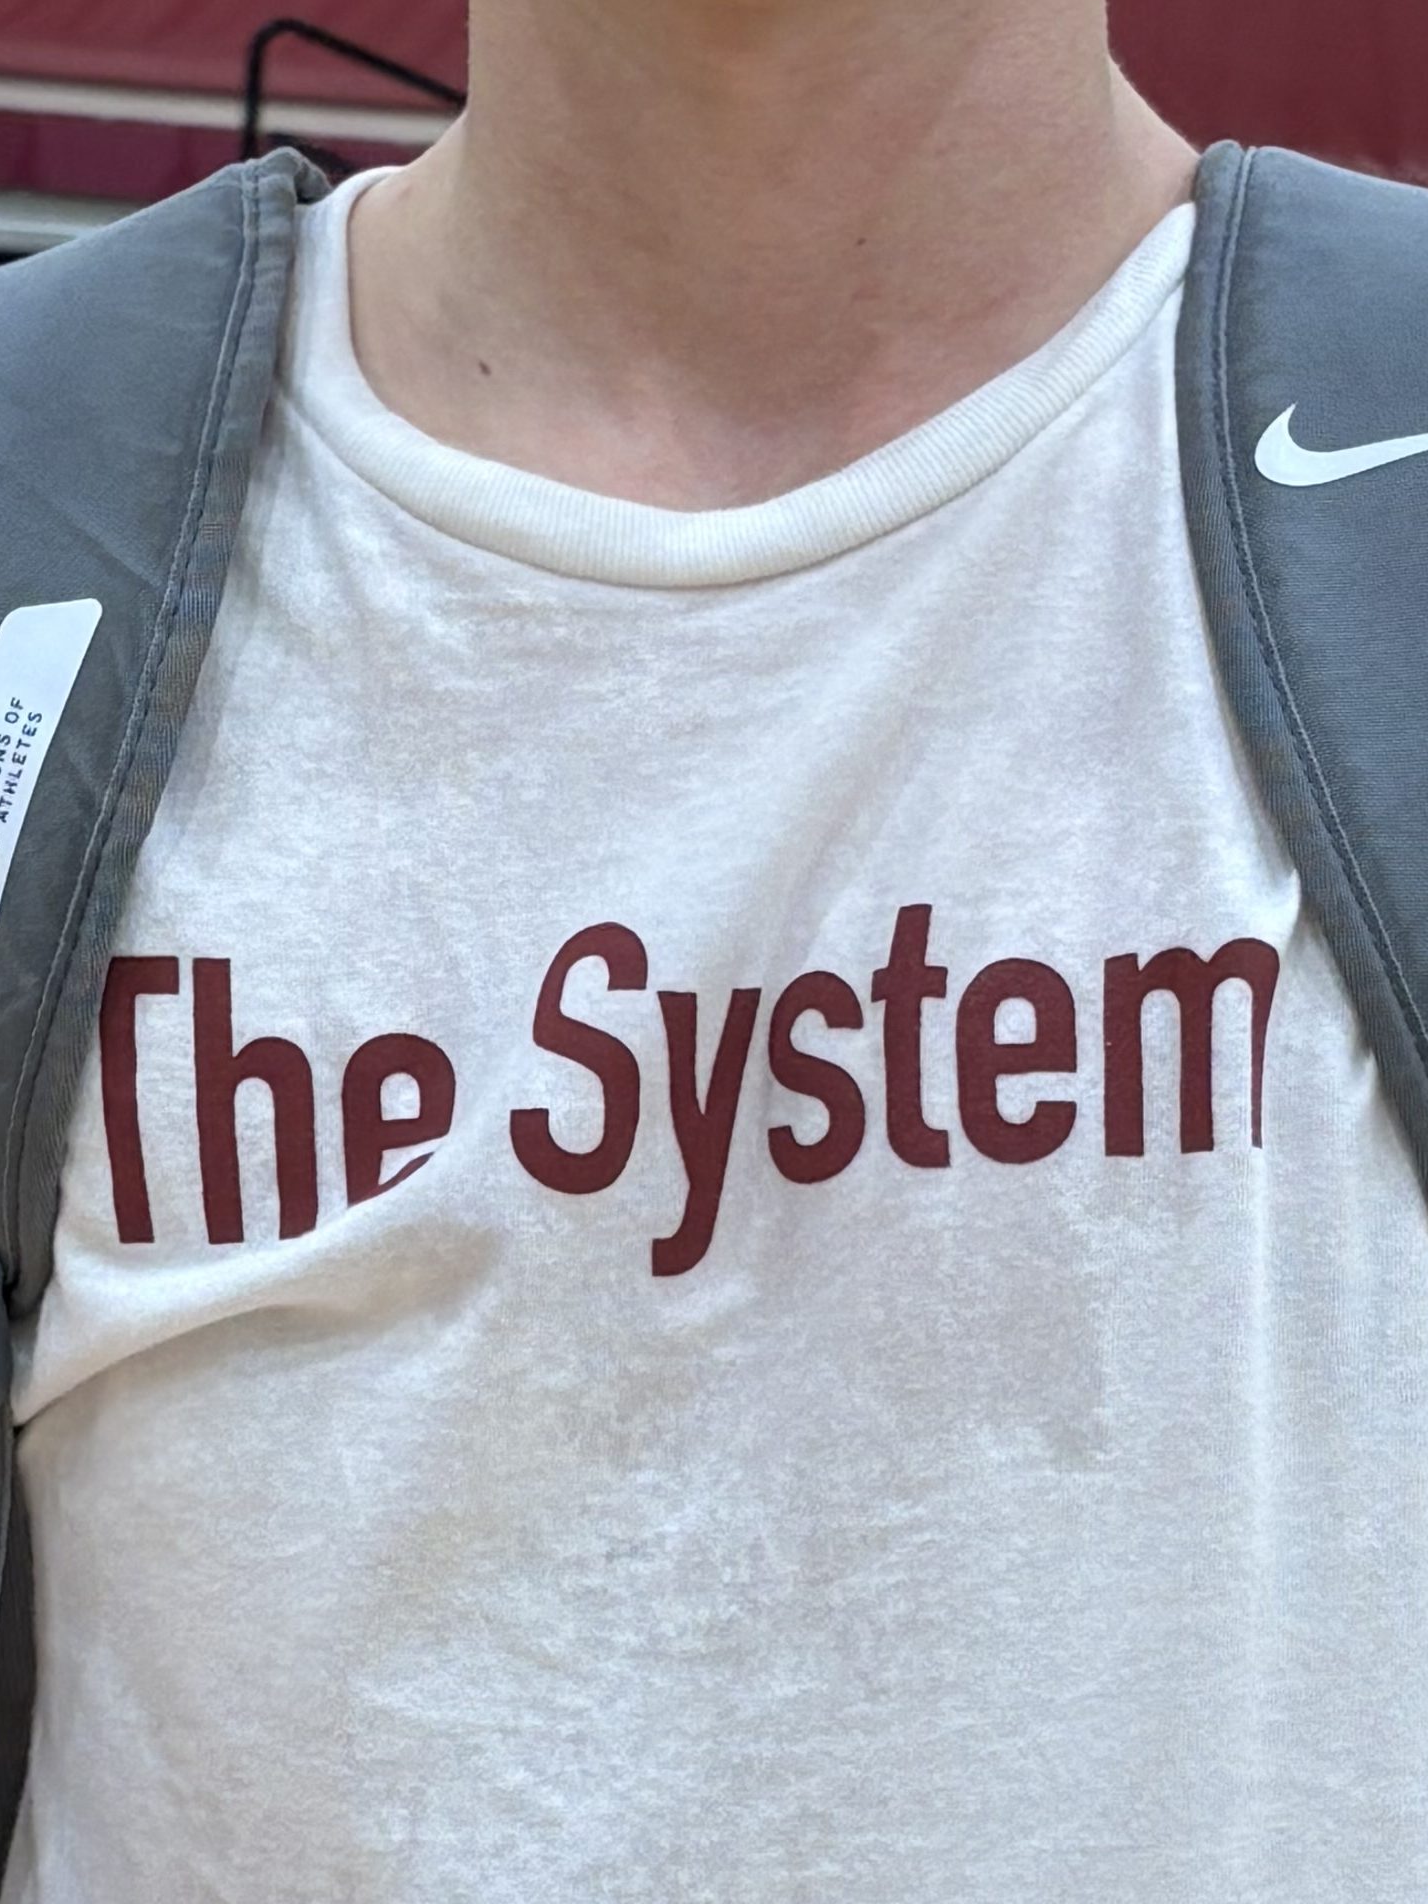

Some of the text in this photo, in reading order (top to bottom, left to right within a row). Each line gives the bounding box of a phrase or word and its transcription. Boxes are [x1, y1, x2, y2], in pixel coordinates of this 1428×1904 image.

[4, 697, 24, 724] OF
[98, 903, 1281, 1277] The System
